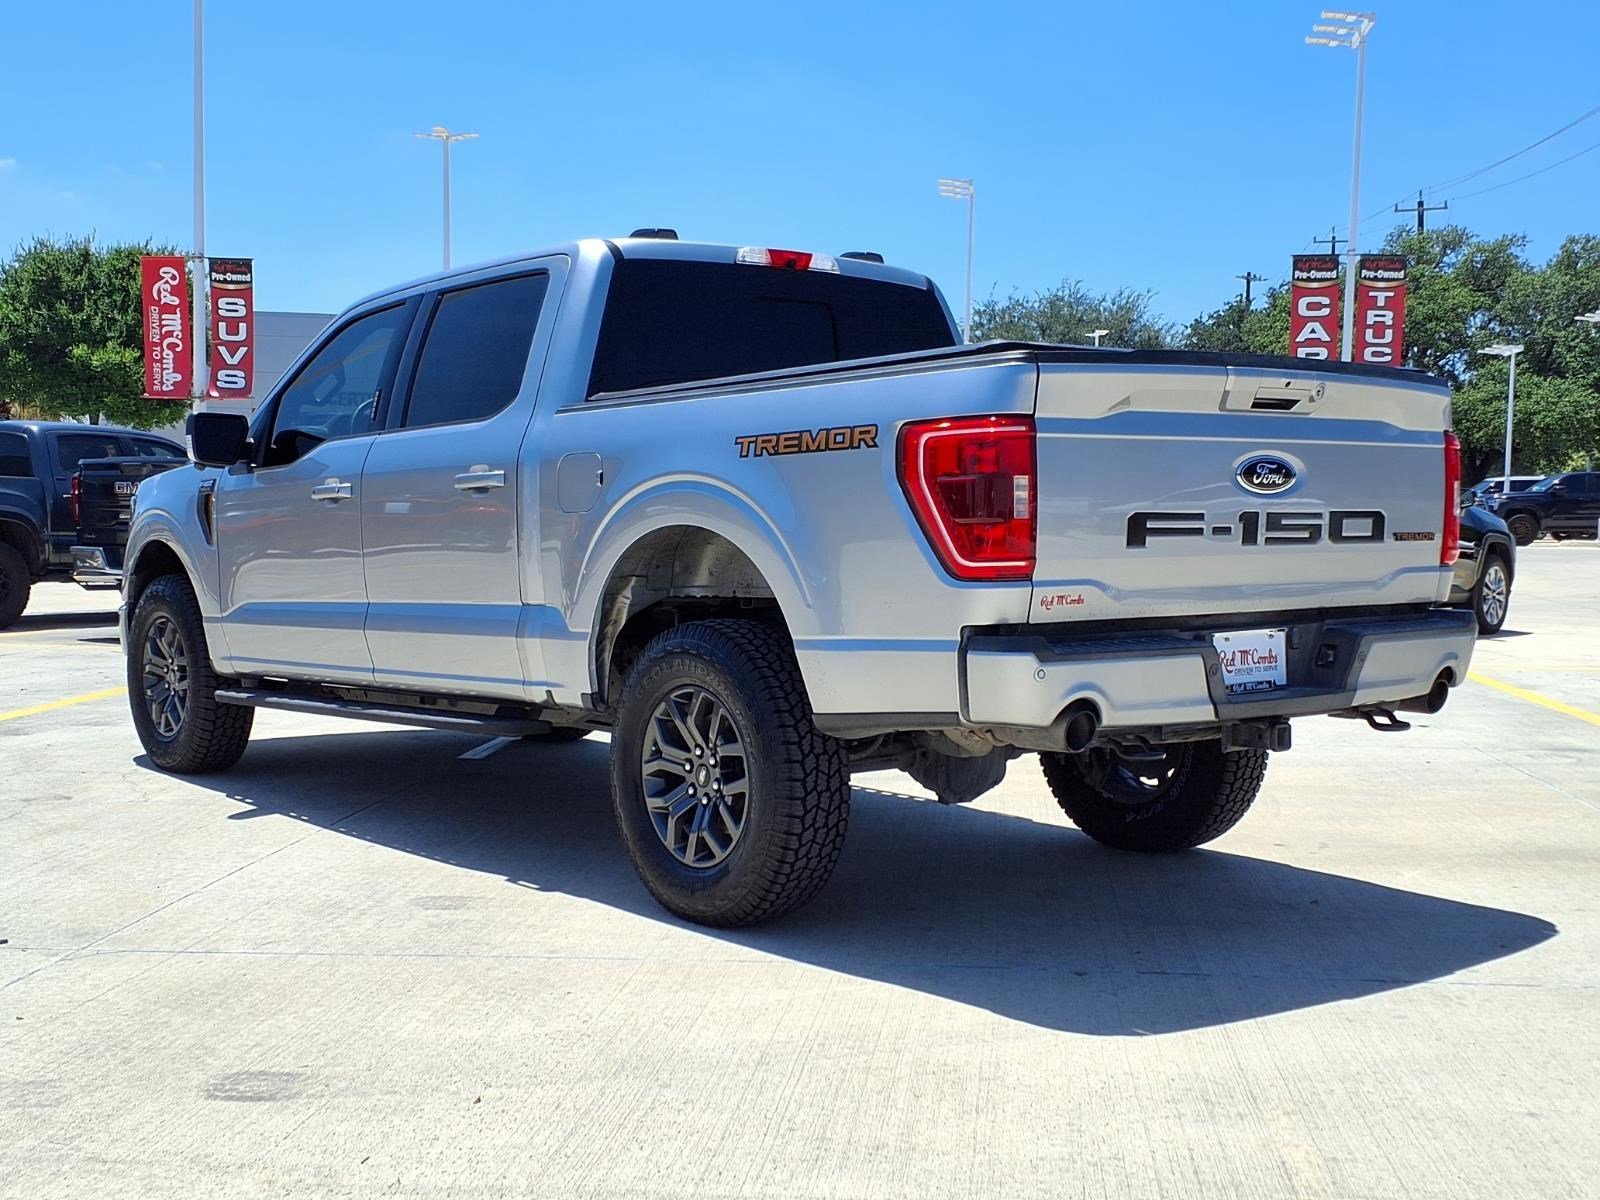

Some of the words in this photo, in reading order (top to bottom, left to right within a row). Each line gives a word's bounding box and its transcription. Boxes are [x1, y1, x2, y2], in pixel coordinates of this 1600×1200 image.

[211, 272, 251, 281] Pre-Owned
[1294, 270, 1337, 279] Pre-Owned
[1361, 269, 1405, 279] Pre-Owned
[152, 266, 180, 306] Red
[151, 306, 160, 343] DRIVEN
[1363, 291, 1395, 363] TRUC
[152, 346, 161, 360] TO
[216, 297, 249, 389] SUVS
[153, 362, 161, 392] SERVE
[734, 423, 879, 458] TREMOR
[1253, 462, 1286, 485] Ford
[114, 481, 140, 494] GM
[1126, 510, 1386, 549] F-150
[1392, 532, 1435, 541] TREMOR
[1040, 595, 1054, 610] Red
[1218, 650, 1236, 673] Red
[1234, 667, 1253, 675] DRIVEN
